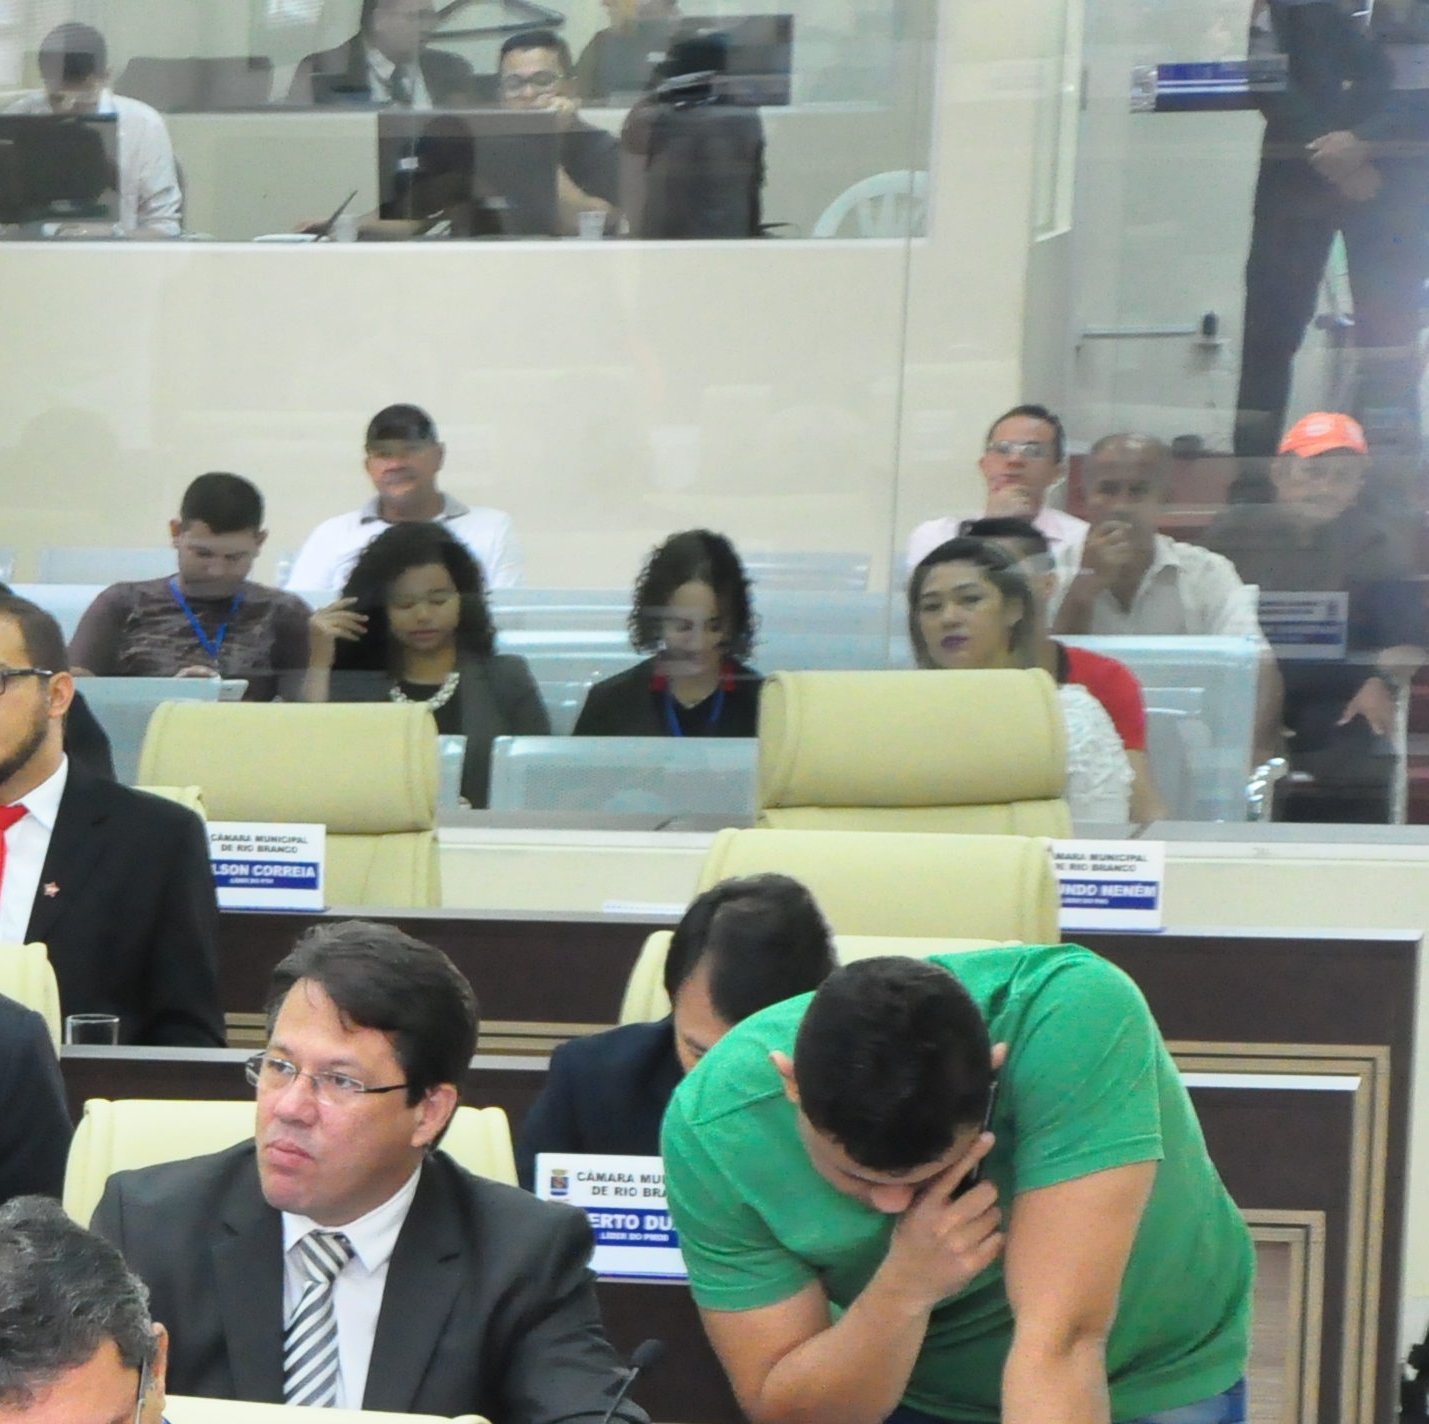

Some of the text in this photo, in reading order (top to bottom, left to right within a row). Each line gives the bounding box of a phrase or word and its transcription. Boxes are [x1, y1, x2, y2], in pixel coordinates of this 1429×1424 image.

[254, 835, 309, 845] MUNICIPAL
[220, 843, 233, 852] DE
[256, 845, 299, 854] BRANCO
[211, 863, 316, 878] LSON CORREIA
[577, 1170, 635, 1184] CÂMARA
[591, 1186, 609, 1197] DE
[614, 1187, 638, 1197] RIO
[587, 1212, 640, 1230] ERTO
